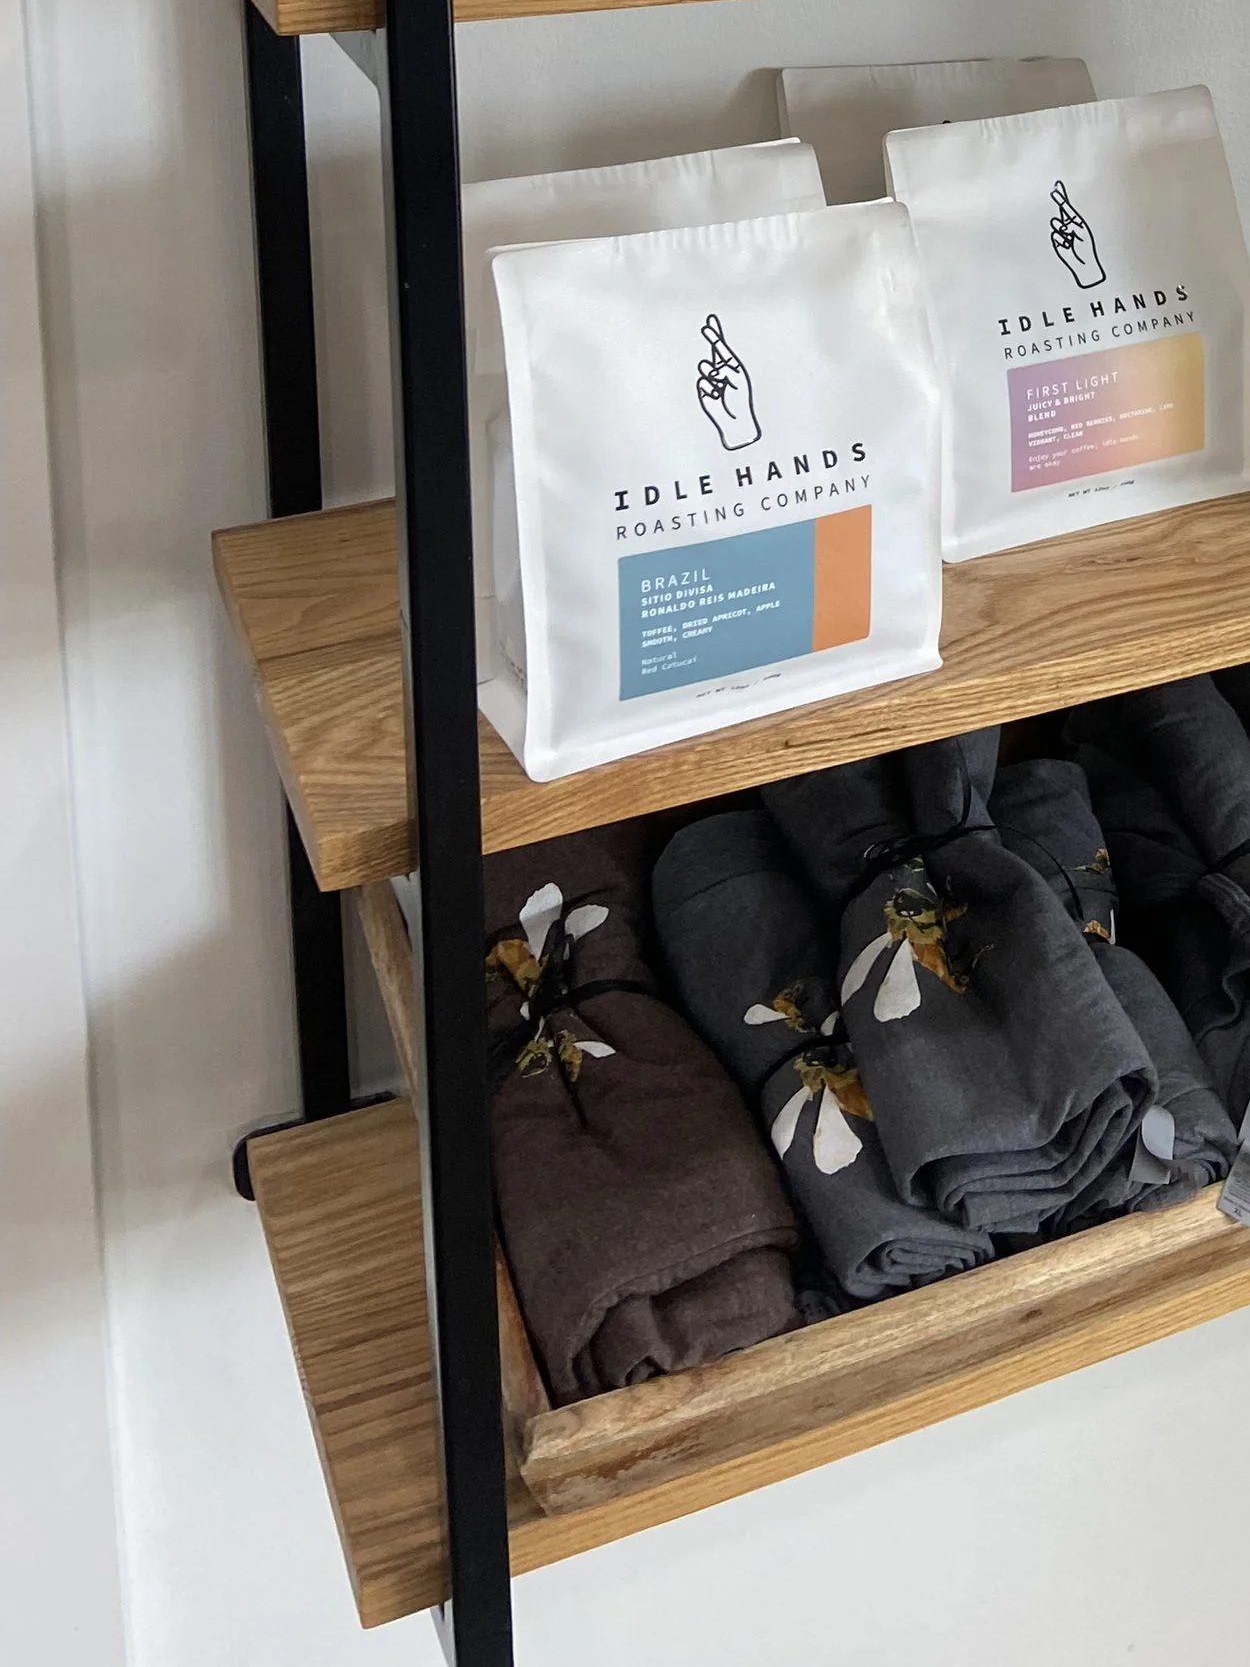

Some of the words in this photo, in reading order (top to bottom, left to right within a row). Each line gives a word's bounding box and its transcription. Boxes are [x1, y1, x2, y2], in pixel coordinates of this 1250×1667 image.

[998, 307, 1075, 336] IDLE
[1090, 285, 1189, 317] HANDS
[1004, 329, 1101, 360] ROASTING
[1111, 310, 1195, 338] COMPANY
[1027, 382, 1068, 400] FIRST
[1076, 371, 1119, 391] LIGHT
[1027, 399, 1052, 412] JUICY
[1055, 399, 1061, 407] &
[1063, 391, 1096, 404] BRIGHT
[1028, 410, 1056, 423] BLEND
[614, 474, 713, 511] IDLE
[735, 442, 867, 487] HANDS
[616, 502, 745, 540] ROASTING
[761, 474, 870, 511] COMPANY
[641, 568, 711, 593] BRAZIL
[641, 593, 672, 607] SITIO
[676, 584, 714, 599] DIVISA
[641, 600, 696, 619] RONALDO
[699, 593, 724, 607] REIS
[728, 582, 776, 600] MADEIRA
[712, 608, 751, 622] APRICOT,
[755, 600, 781, 613] APPLE
[641, 651, 677, 666] Natural
[641, 666, 658, 675] Red
